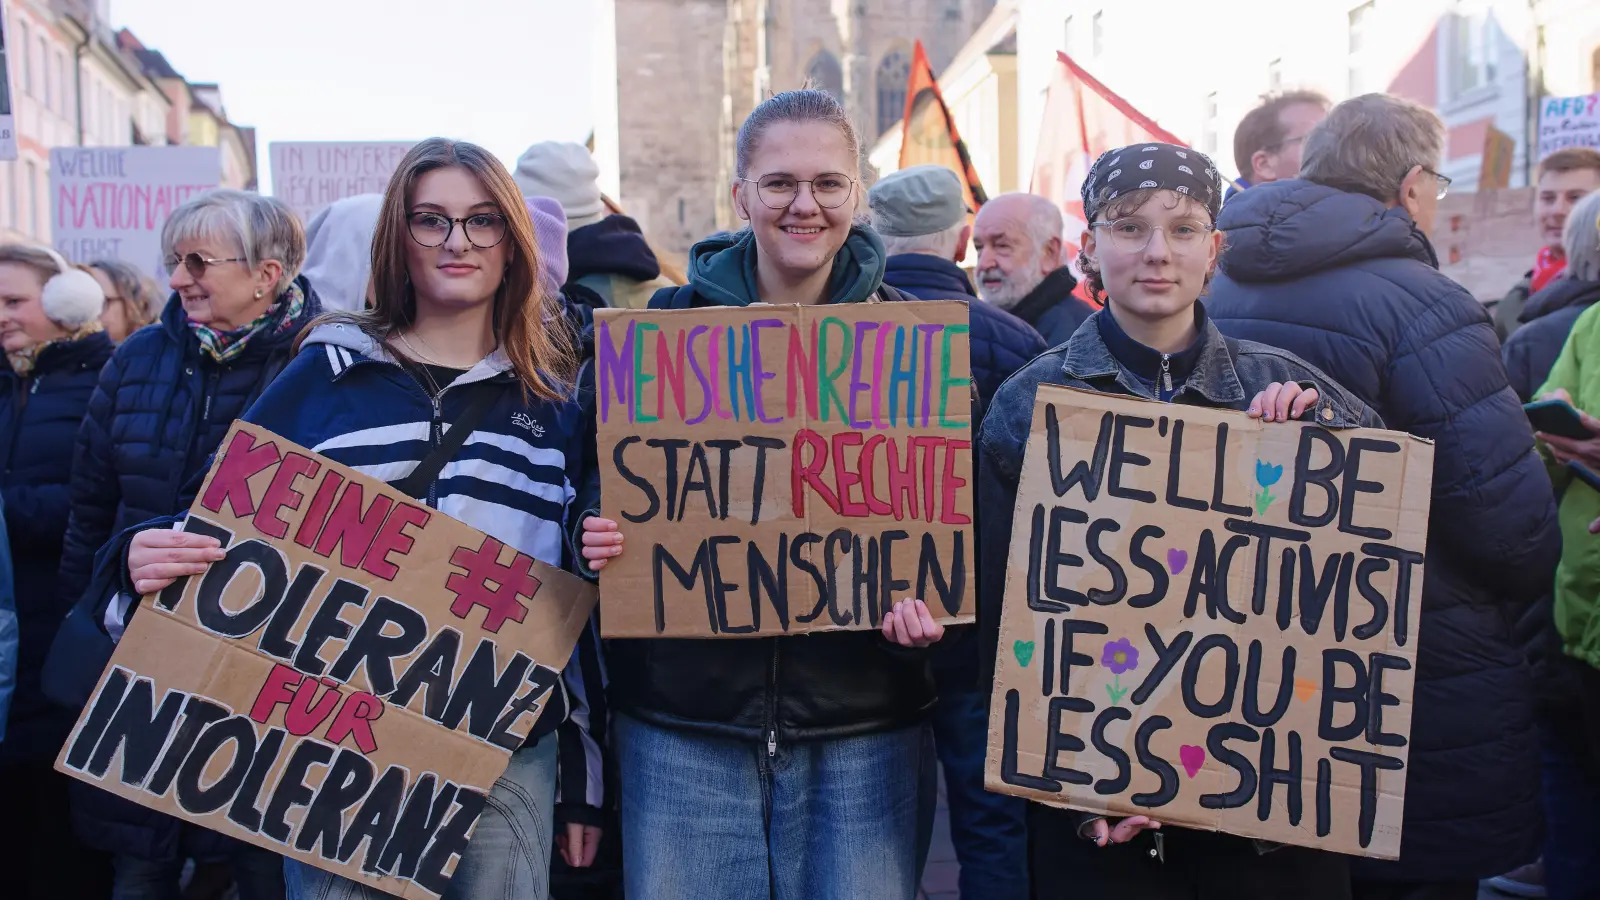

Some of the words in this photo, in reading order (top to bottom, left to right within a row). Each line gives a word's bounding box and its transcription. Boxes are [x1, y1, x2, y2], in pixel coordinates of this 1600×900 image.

[280, 147, 303, 173] IN
[600, 317, 970, 429] MENSCHENRECHTE
[201, 429, 431, 581] KEINE
[613, 435, 786, 526] STATT
[791, 428, 972, 525] RECHTE
[1045, 403, 1252, 517] WE'LL
[1288, 426, 1401, 539] BE
[153, 514, 561, 752] TOLERANZ
[653, 527, 966, 634] MENSCHEN
[1027, 503, 1171, 613] LESS
[1183, 518, 1424, 647] ACTIVIST
[250, 663, 385, 754] FÜR
[1042, 617, 1109, 696] IF
[1131, 622, 1296, 728] YOU
[1317, 648, 1411, 746] BE
[65, 666, 489, 900] INTOLERANZ
[1000, 688, 1180, 807] LESS
[1199, 722, 1404, 848] SHIT
